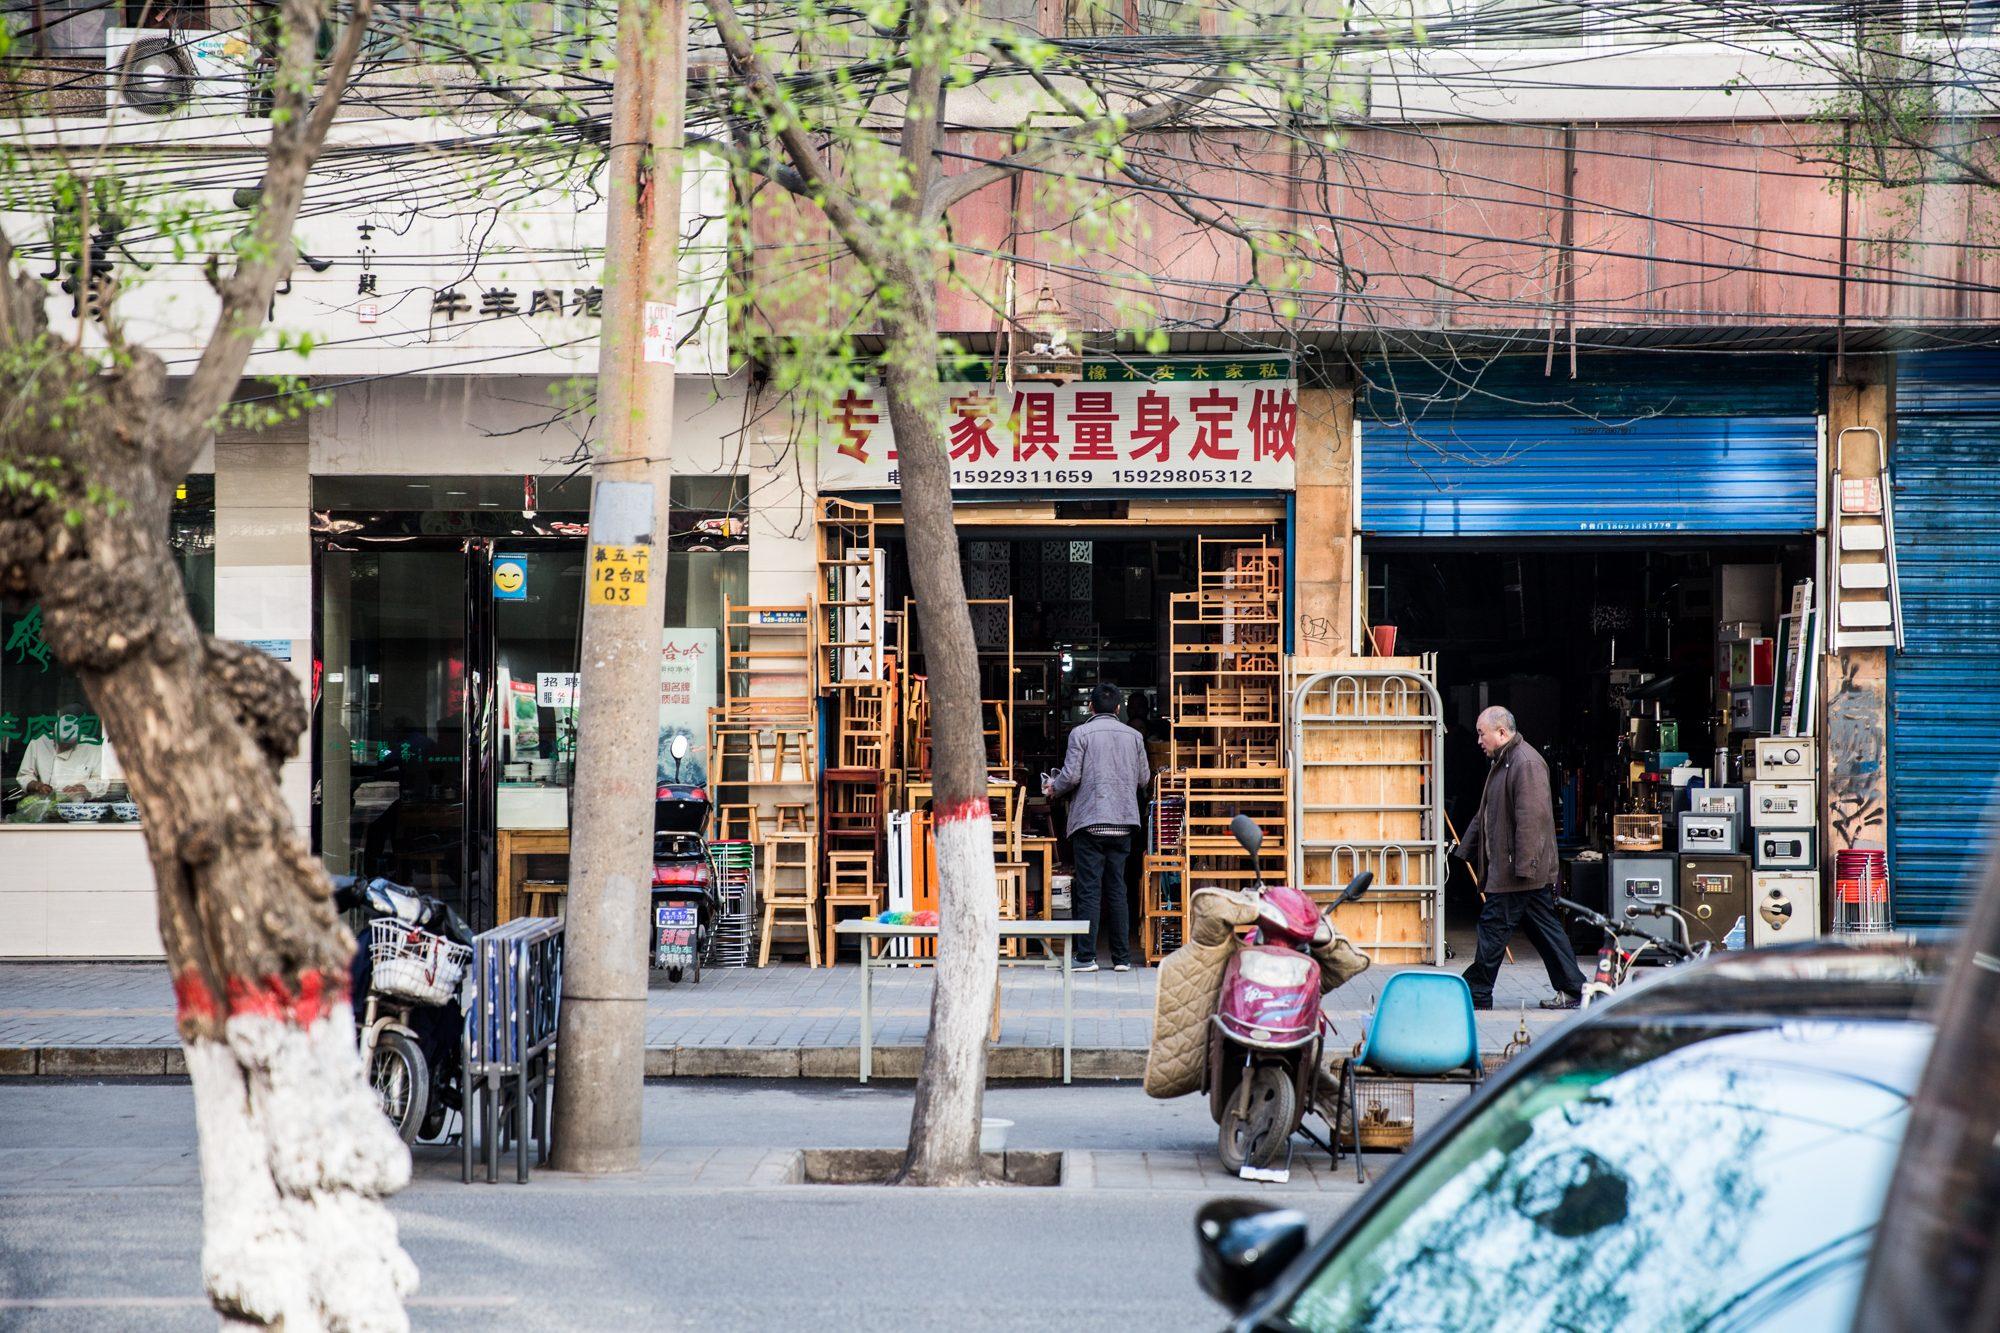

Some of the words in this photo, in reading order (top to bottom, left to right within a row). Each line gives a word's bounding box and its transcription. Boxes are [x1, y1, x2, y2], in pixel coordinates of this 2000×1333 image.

[827, 388, 1297, 464] 专家俱量身定做
[953, 470, 1093, 484] 15929311659
[1112, 470, 1253, 484] 15929805312
[595, 567, 646, 584] 12台区
[603, 586, 630, 602] 03
[543, 676, 580, 688] 招聘
